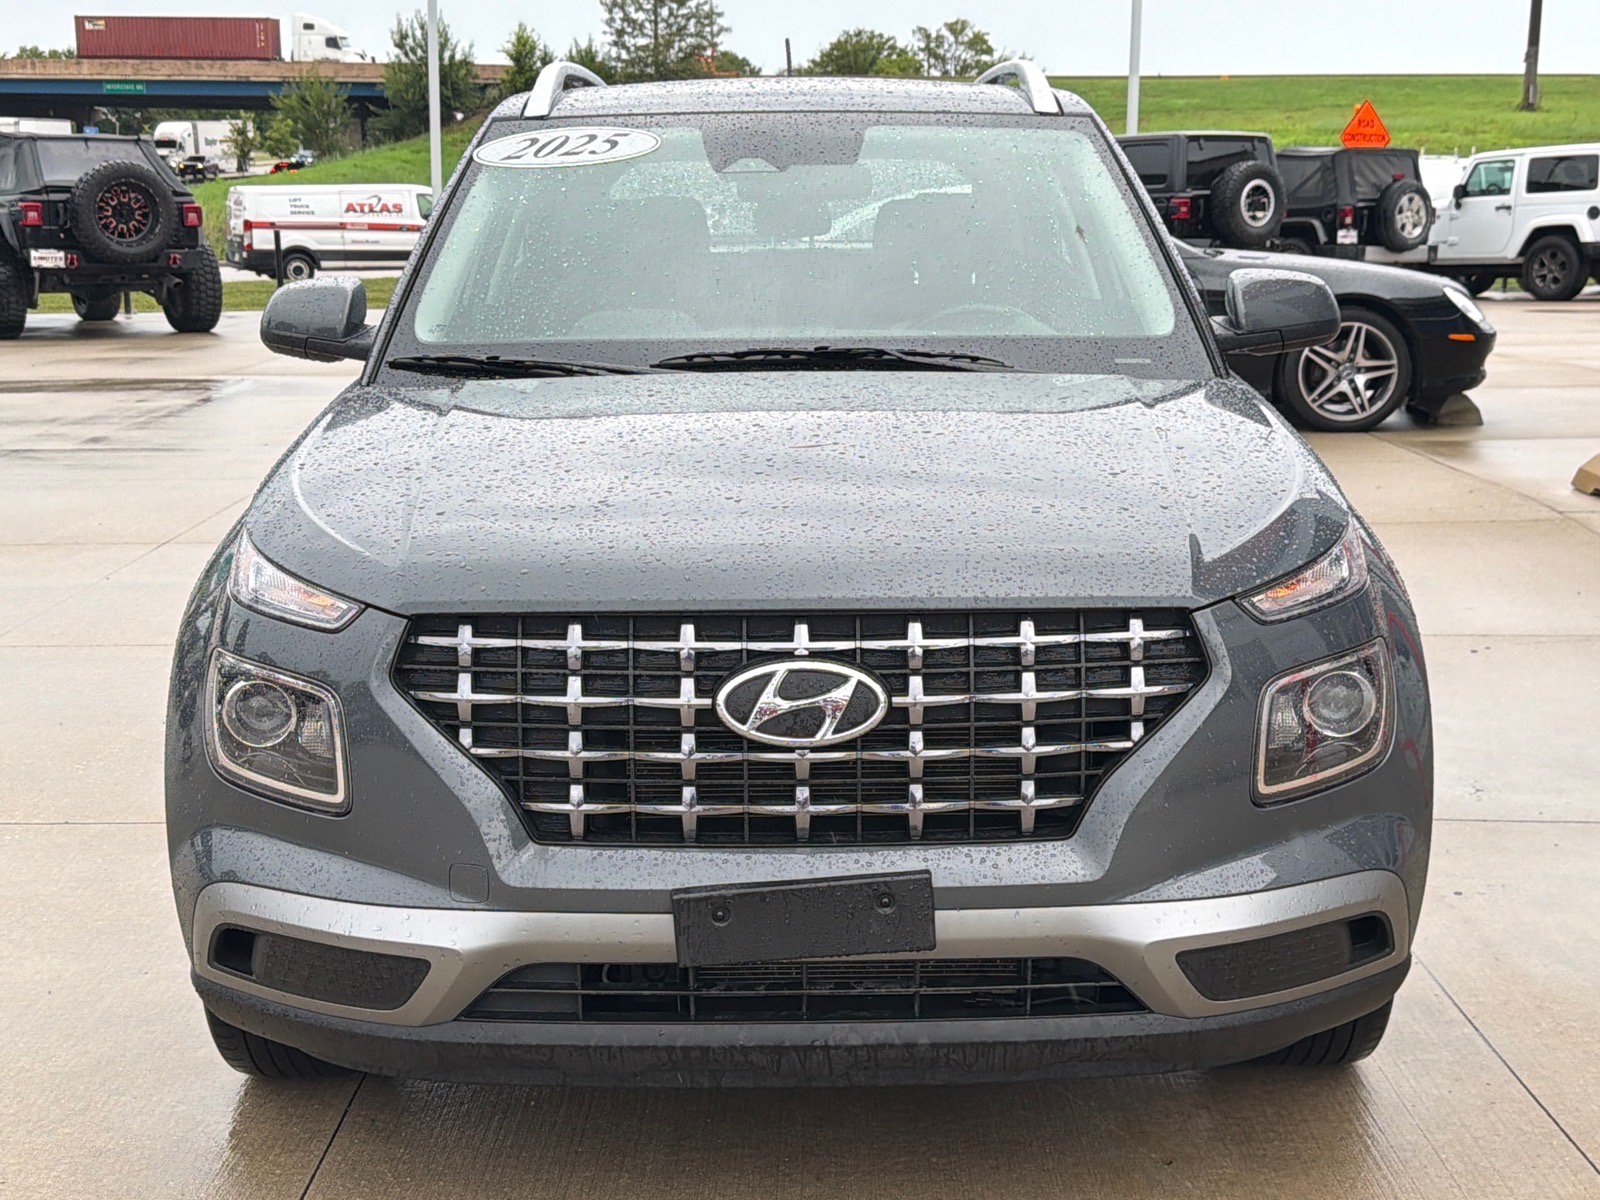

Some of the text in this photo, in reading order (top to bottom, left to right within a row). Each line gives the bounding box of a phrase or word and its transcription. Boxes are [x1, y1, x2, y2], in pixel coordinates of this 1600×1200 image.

[1358, 119, 1375, 128] ROAD
[1343, 133, 1386, 142] CONSTRUCTION
[500, 133, 631, 161] 2025
[344, 203, 403, 213] ATLAS
